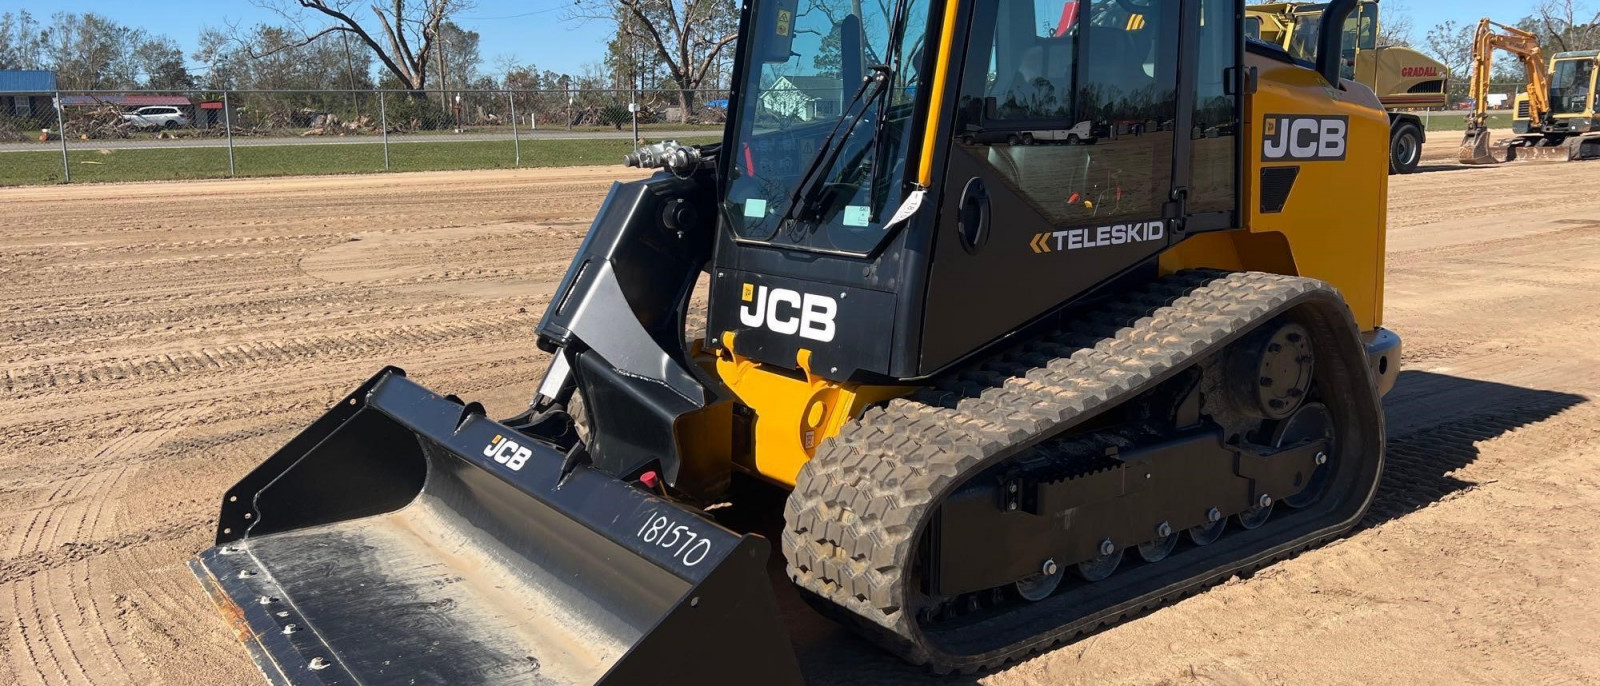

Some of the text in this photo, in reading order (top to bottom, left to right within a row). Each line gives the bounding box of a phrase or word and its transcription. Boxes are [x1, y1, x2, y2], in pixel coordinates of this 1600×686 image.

[1401, 66, 1437, 77] GRADALL
[1264, 118, 1346, 158] JCB
[1052, 220, 1164, 251] TELESKID
[740, 285, 838, 343] JCB
[483, 437, 533, 471] JCB
[637, 511, 712, 567] 181570
